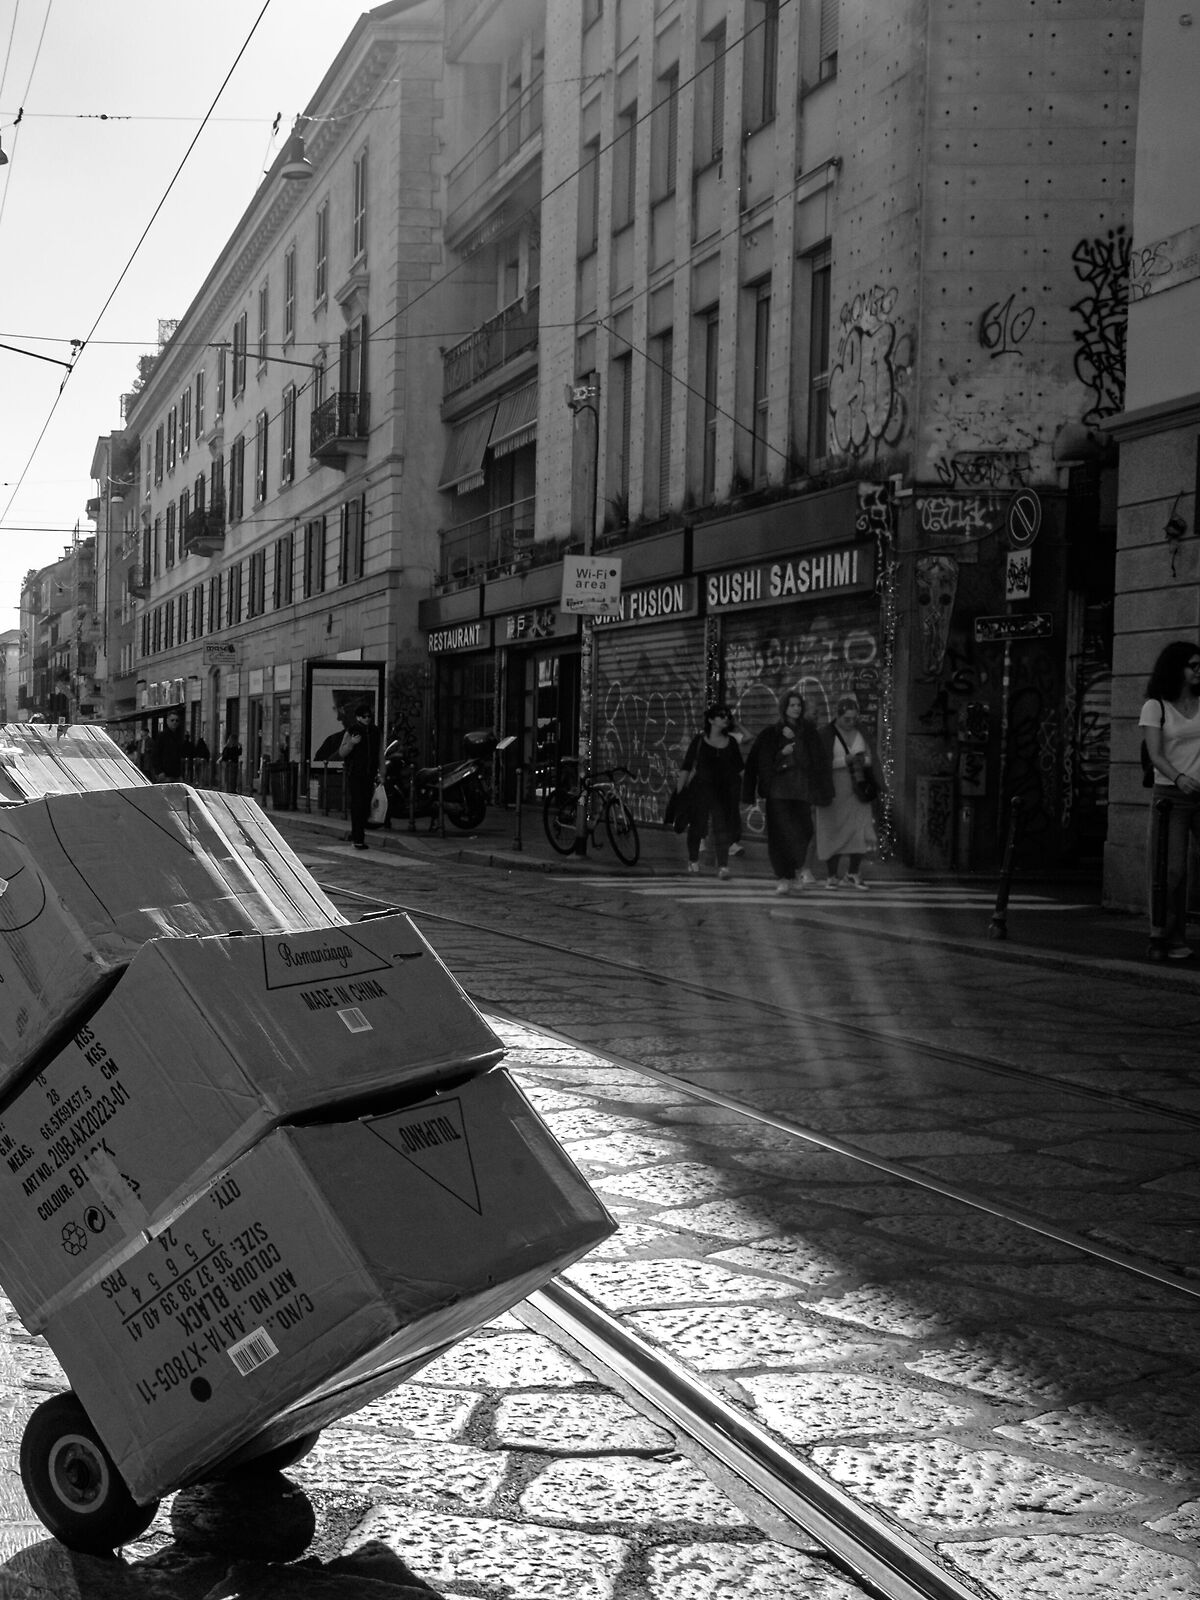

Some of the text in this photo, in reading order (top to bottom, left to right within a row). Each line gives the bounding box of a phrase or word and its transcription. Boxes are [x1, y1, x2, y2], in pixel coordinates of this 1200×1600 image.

[576, 568, 607, 580] Wi-Fi
[576, 580, 606, 589] area
[708, 550, 859, 606] SUSHI SASHIMI
[630, 584, 683, 619] FUSION
[428, 624, 481, 652] RESTAURANT
[299, 979, 387, 1010] MADE IN CHINA
[72, 1024, 94, 1050] KGS
[46, 1088, 60, 1106] 28
[84, 1041, 106, 1066] KGS
[6, 1057, 118, 1173] MEAS: 66.5X59X57.5 CM
[398, 1116, 461, 1152] TULIPANO
[21, 1172, 40, 1196] ART
[35, 1162, 55, 1182] NO:
[37, 1183, 74, 1220] COLOUR:
[100, 1178, 241, 1298] QTY: 24 PRS
[229, 1221, 268, 1256] SIZE:
[114, 1228, 215, 1316] 3 5 6 5 4 1
[195, 1264, 214, 1288] 37
[268, 1268, 297, 1300] ART
[159, 1291, 179, 1315] 39
[175, 1242, 281, 1336] COLOUR: BLACK
[176, 1278, 196, 1301] 38
[126, 1321, 142, 1341] 41
[142, 1307, 159, 1329] 40
